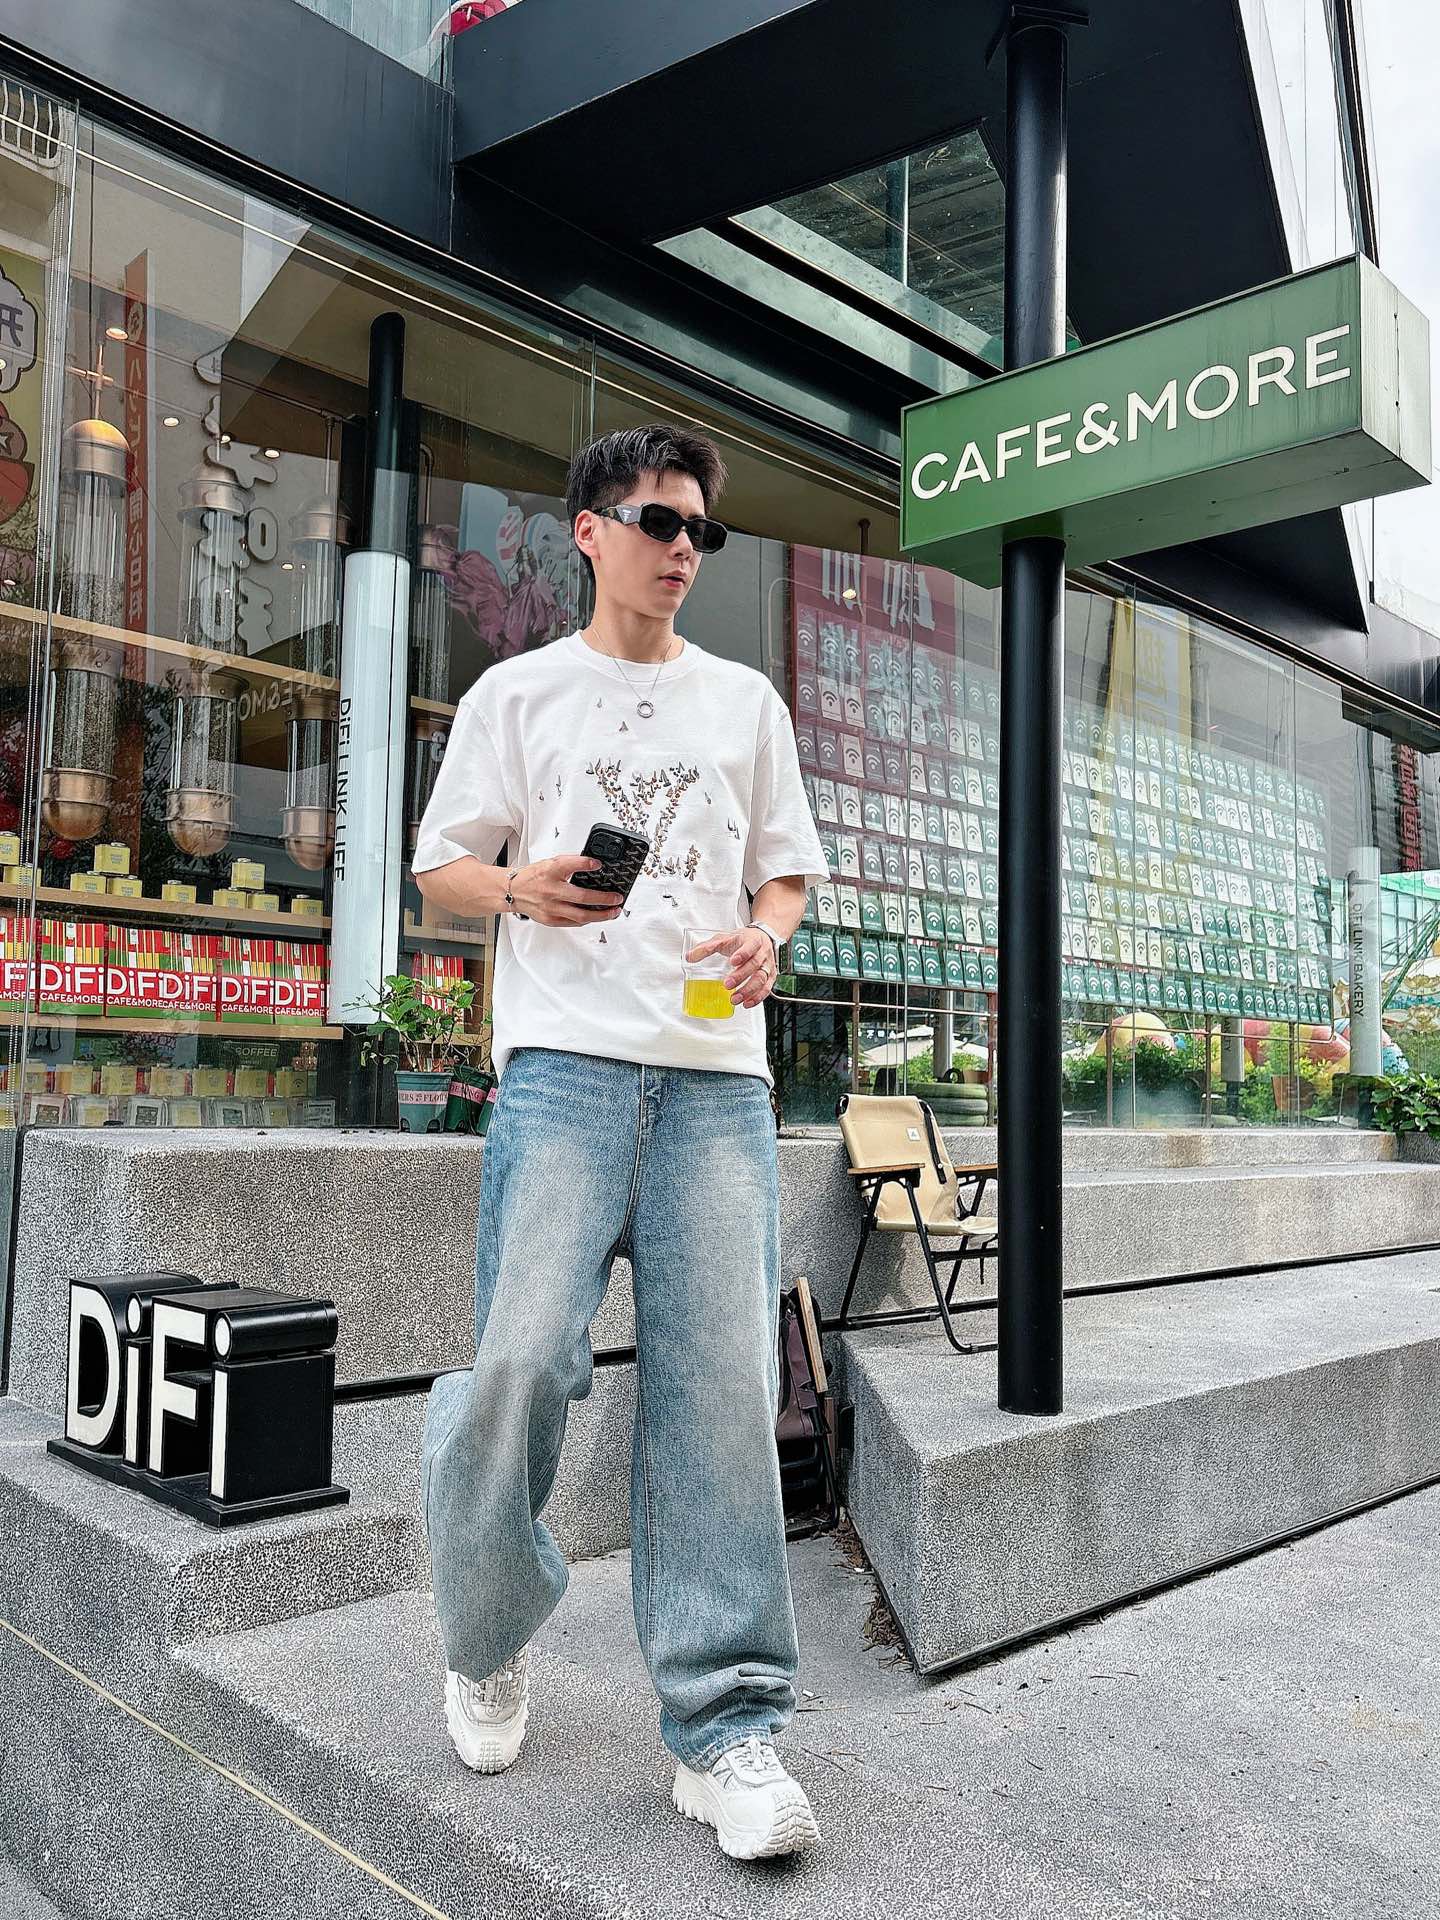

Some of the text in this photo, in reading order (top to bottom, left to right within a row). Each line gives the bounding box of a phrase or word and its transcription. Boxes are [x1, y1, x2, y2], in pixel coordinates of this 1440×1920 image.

[911, 324, 1351, 499] CAFE&MORE
[334, 698, 351, 881] DiFi LINK LIFE
[1353, 930, 1362, 959] LINK
[40, 963, 105, 993] DiFi
[107, 967, 164, 998] DiFi
[163, 973, 217, 1002] DiFi
[222, 976, 274, 1005] DiFi
[1353, 963, 1364, 1016] BAKERY
[40, 992, 104, 1004] CAFE&MORE
[107, 996, 163, 1009] CAFE&MORE
[163, 1000, 216, 1011] CAFE&MORE
[275, 980, 325, 1007] DiFi
[222, 1004, 273, 1015] CAFE&MORE
[275, 1007, 325, 1017] CAFE&MORE
[67, 1284, 232, 1499] DiFi
